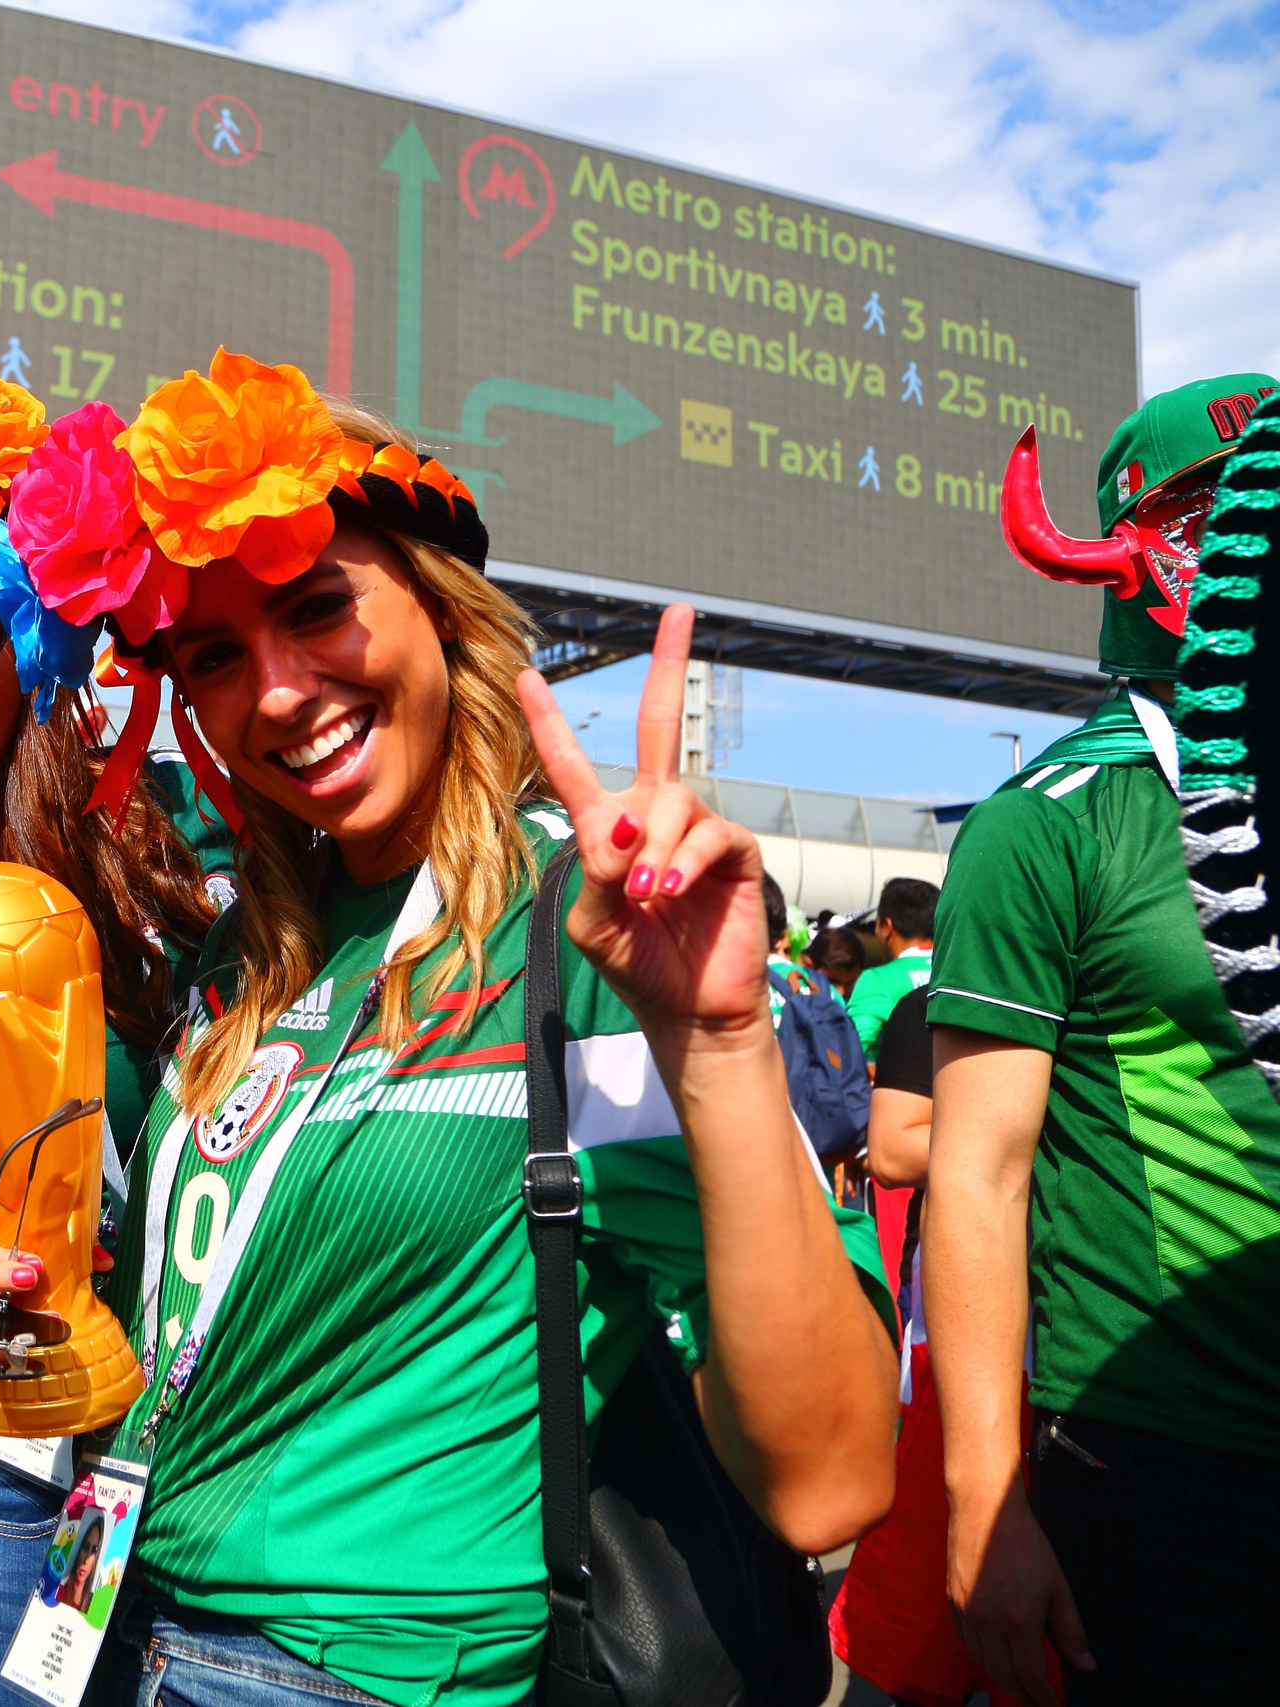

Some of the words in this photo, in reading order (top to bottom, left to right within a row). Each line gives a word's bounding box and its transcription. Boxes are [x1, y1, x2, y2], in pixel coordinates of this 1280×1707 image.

[10, 74, 167, 148] entry
[569, 155, 721, 231] Metro
[734, 201, 897, 276] station:
[570, 219, 848, 326] Sportivnaya
[901, 297, 926, 342] 3
[941, 315, 1028, 367] min.
[48, 344, 117, 401] 17
[571, 284, 886, 400] Frunzenskaya
[936, 369, 988, 420] 25
[999, 392, 1084, 442] min.
[747, 420, 843, 483] Taxi
[894, 454, 921, 499] 8
[277, 1011, 330, 1031] adidas
